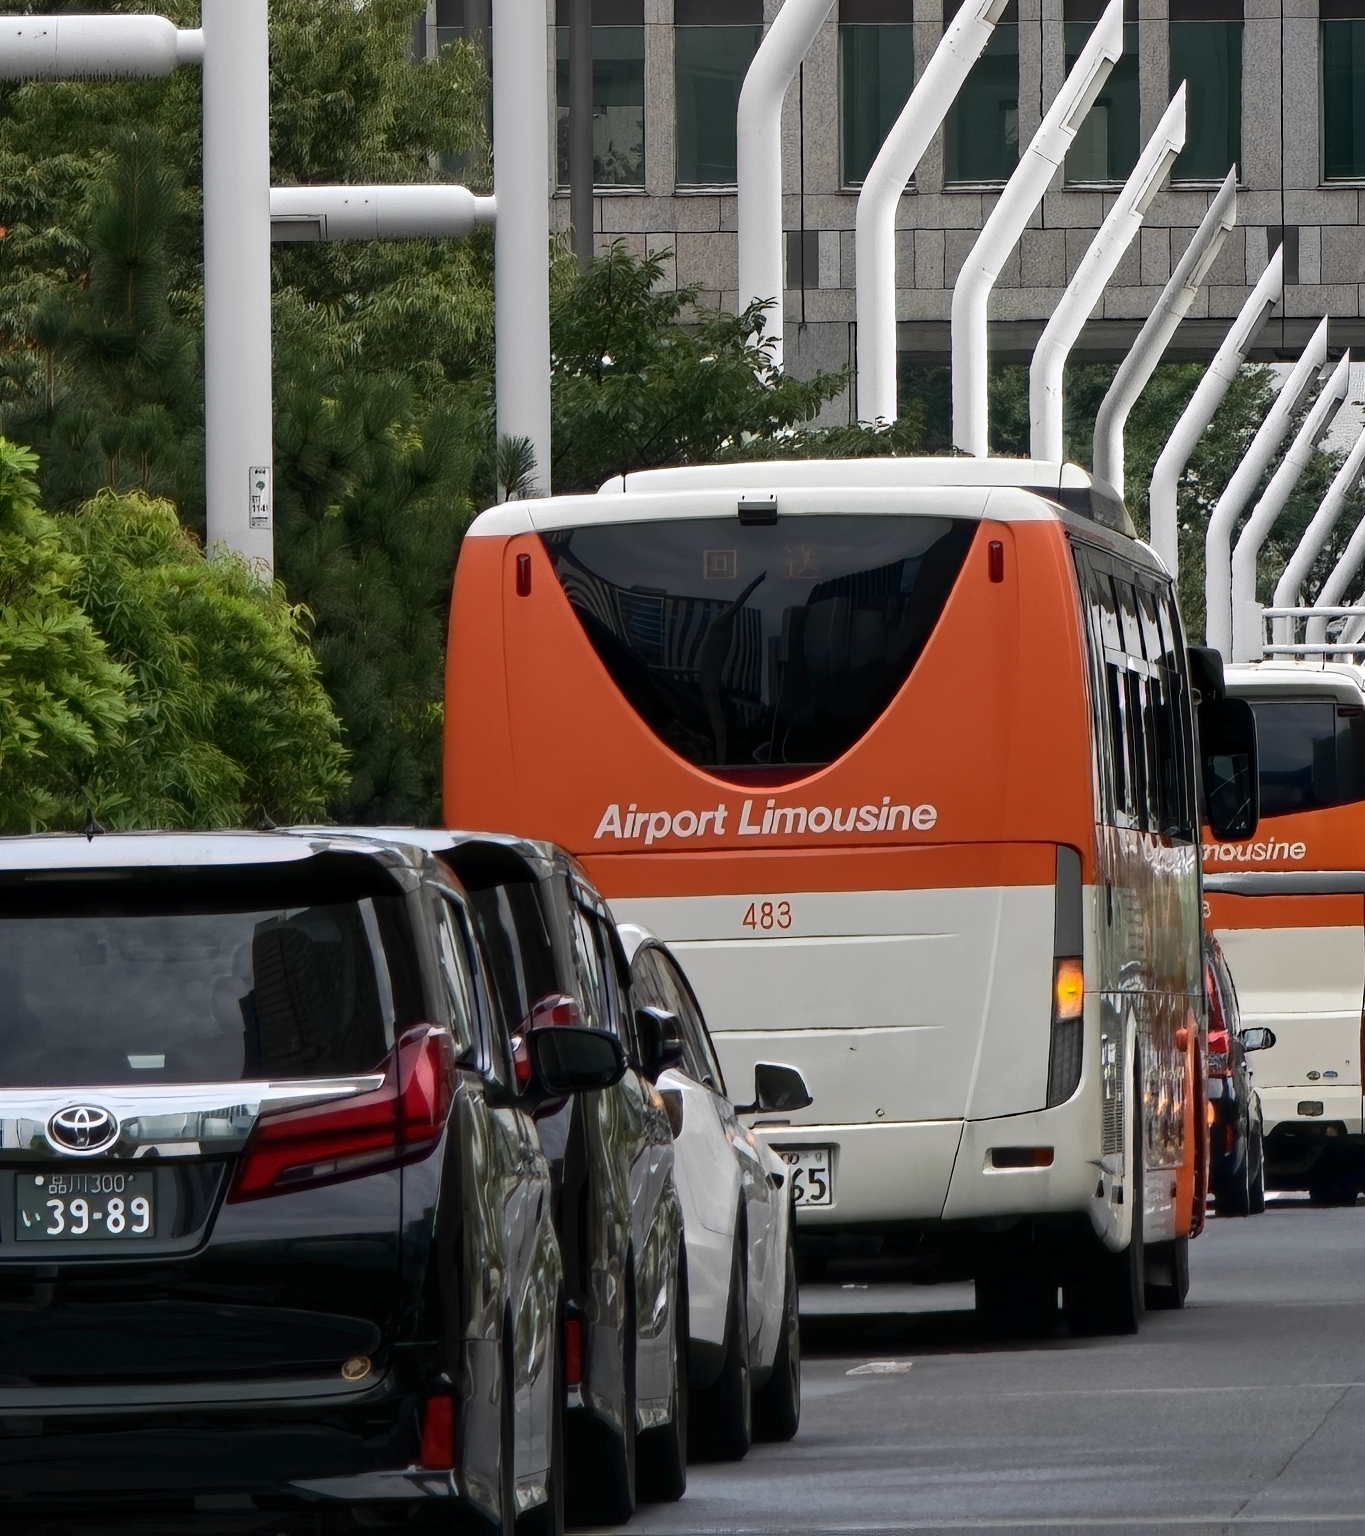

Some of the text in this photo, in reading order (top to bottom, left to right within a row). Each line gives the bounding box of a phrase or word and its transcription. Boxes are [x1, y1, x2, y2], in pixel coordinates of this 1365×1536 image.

[594, 796, 938, 845] Airport Limousine
[1202, 837, 1307, 862] mousine
[742, 901, 793, 930] 483
[46, 1197, 150, 1235] 39-89
